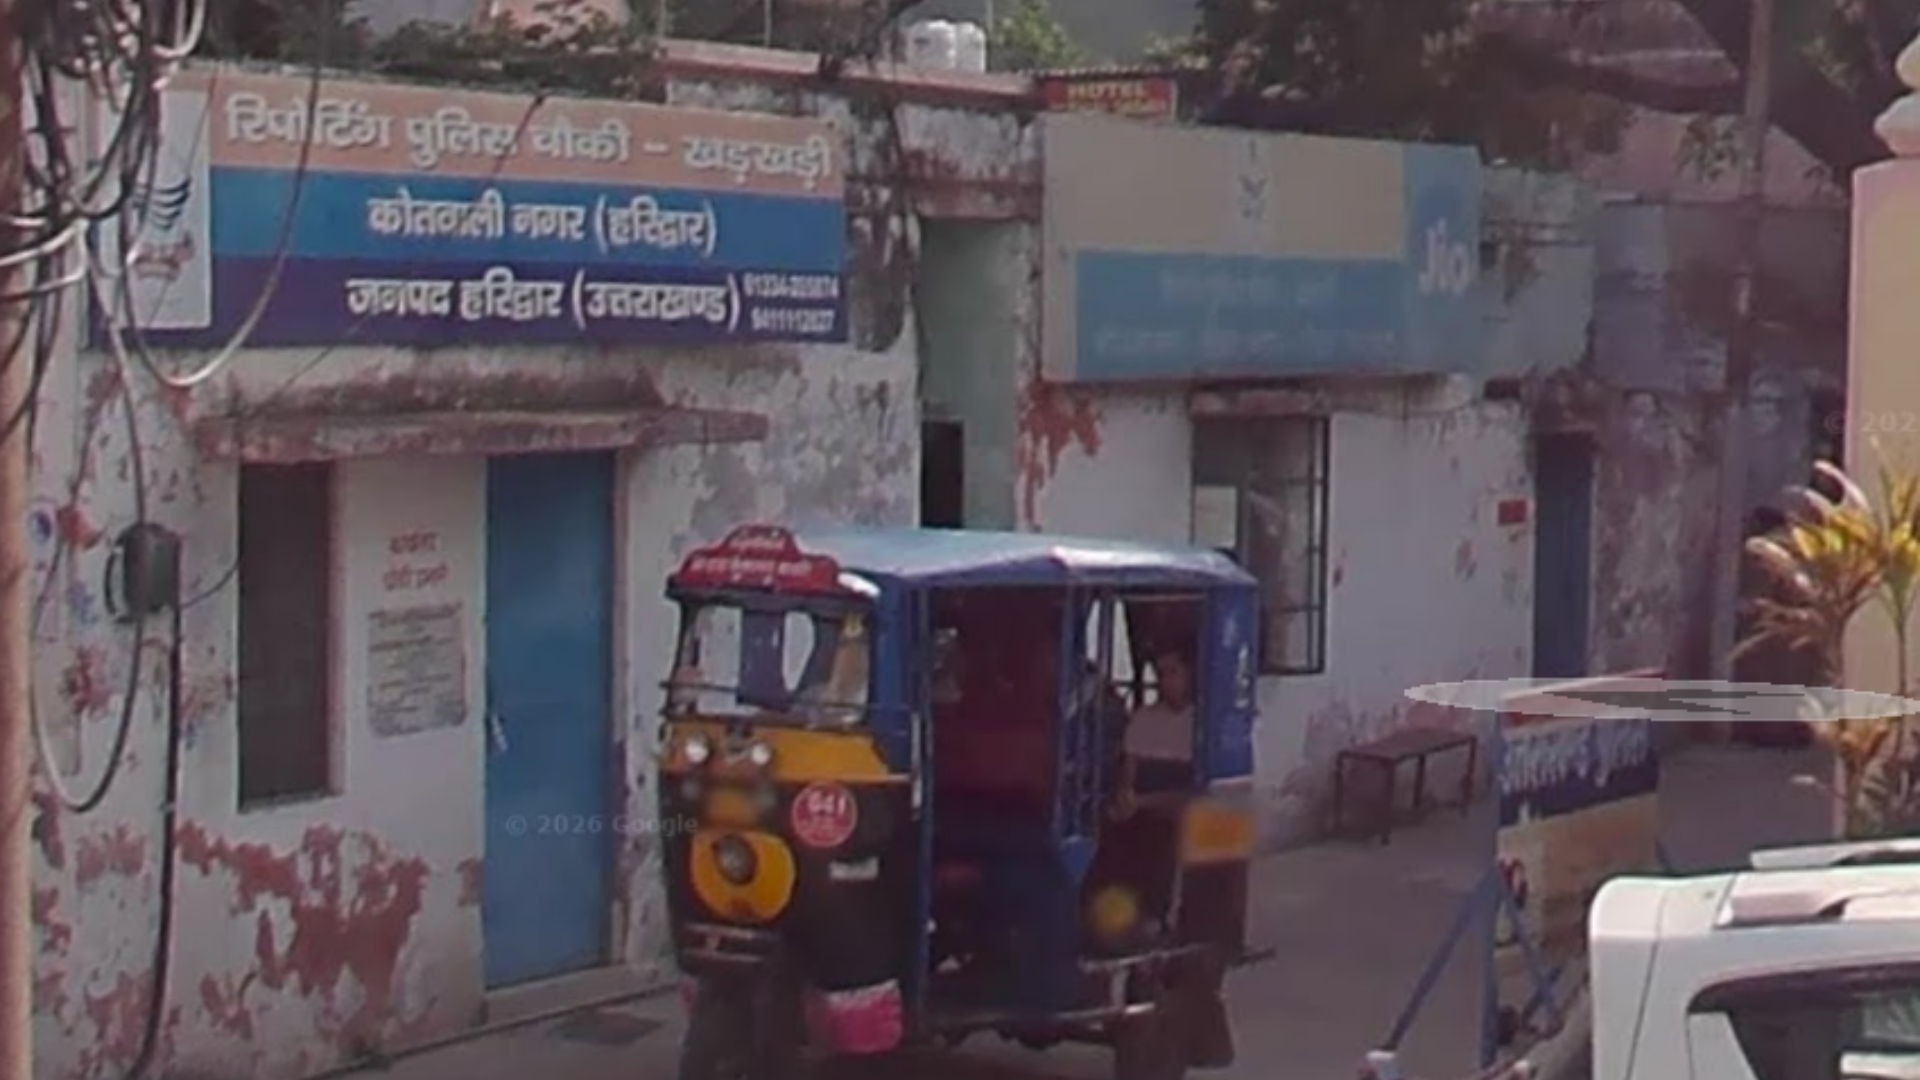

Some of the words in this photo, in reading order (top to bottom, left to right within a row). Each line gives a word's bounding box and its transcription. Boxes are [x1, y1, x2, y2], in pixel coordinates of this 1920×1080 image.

[1067, 80, 1151, 101] HOTEL
[406, 106, 517, 166] पुलिस
[682, 134, 831, 190] खड़खड़ी
[512, 203, 587, 241] नगर
[594, 194, 716, 257] (हरिद्वार)
[1418, 216, 1470, 297] Jio
[345, 278, 455, 317] जनपद
[460, 267, 565, 320] हरिद्वार
[571, 268, 741, 333] (उत्तराखण्ड)
